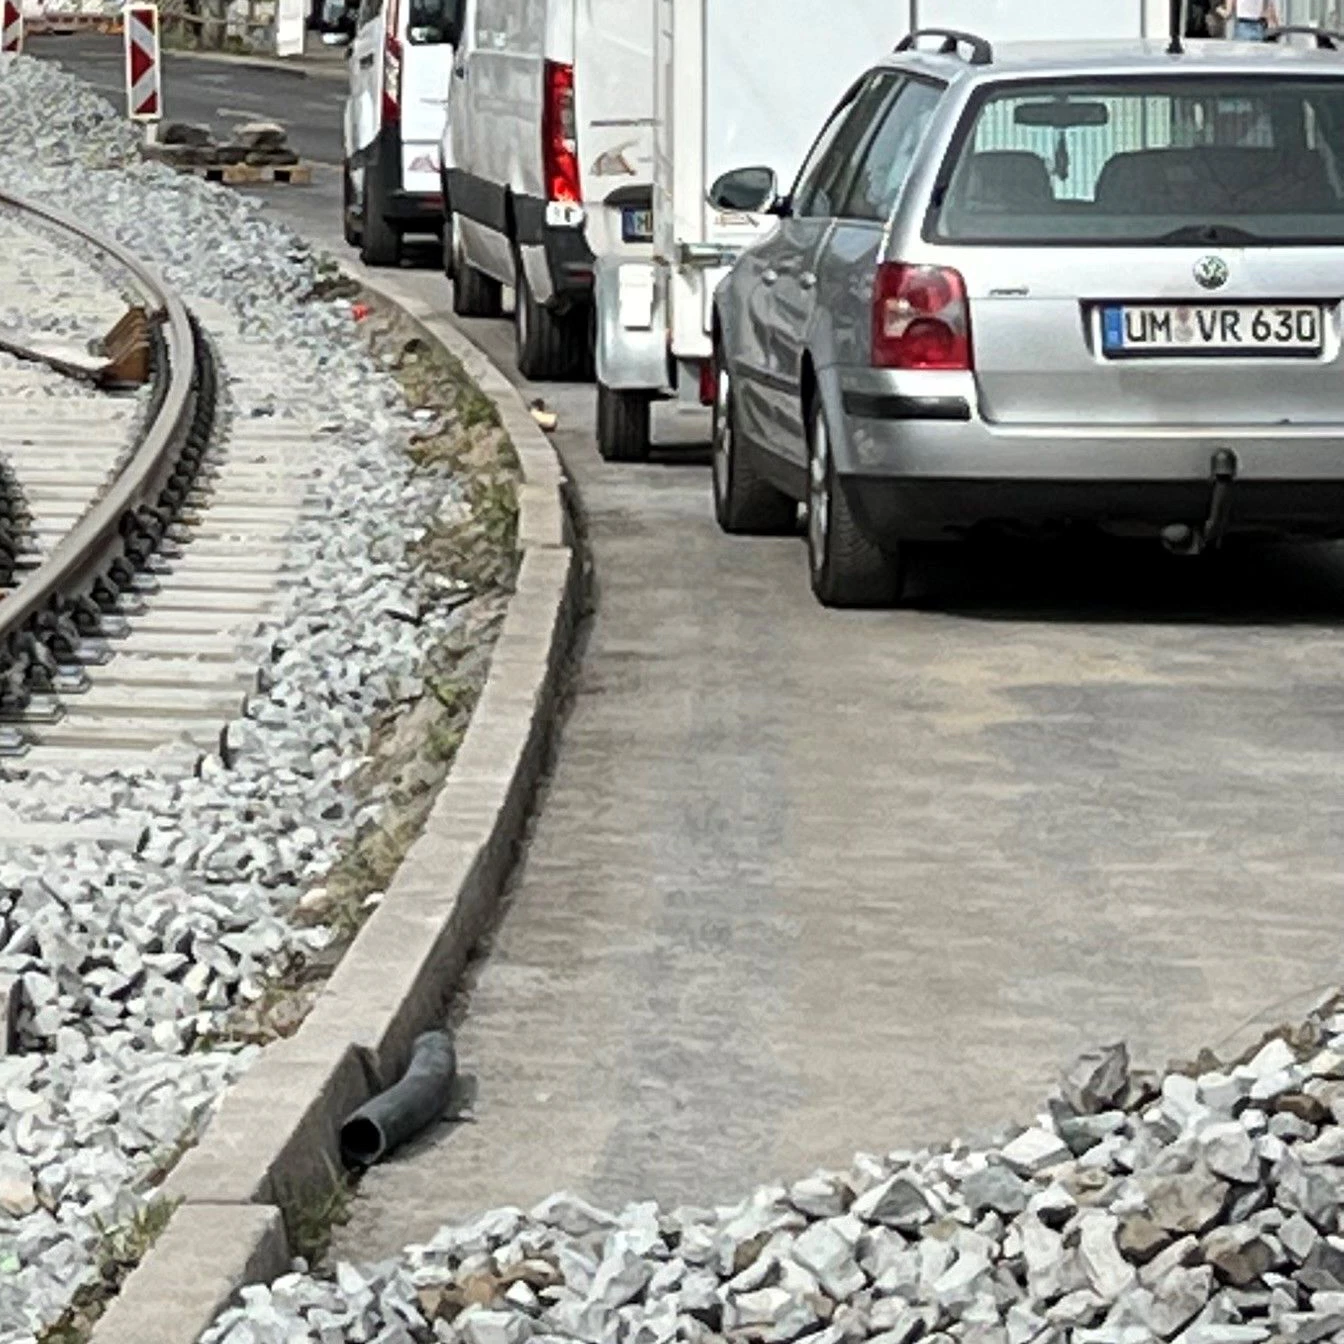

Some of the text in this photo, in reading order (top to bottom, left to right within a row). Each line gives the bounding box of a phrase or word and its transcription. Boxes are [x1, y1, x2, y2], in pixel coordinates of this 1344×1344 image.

[1124, 307, 1318, 343] UM VR 630
